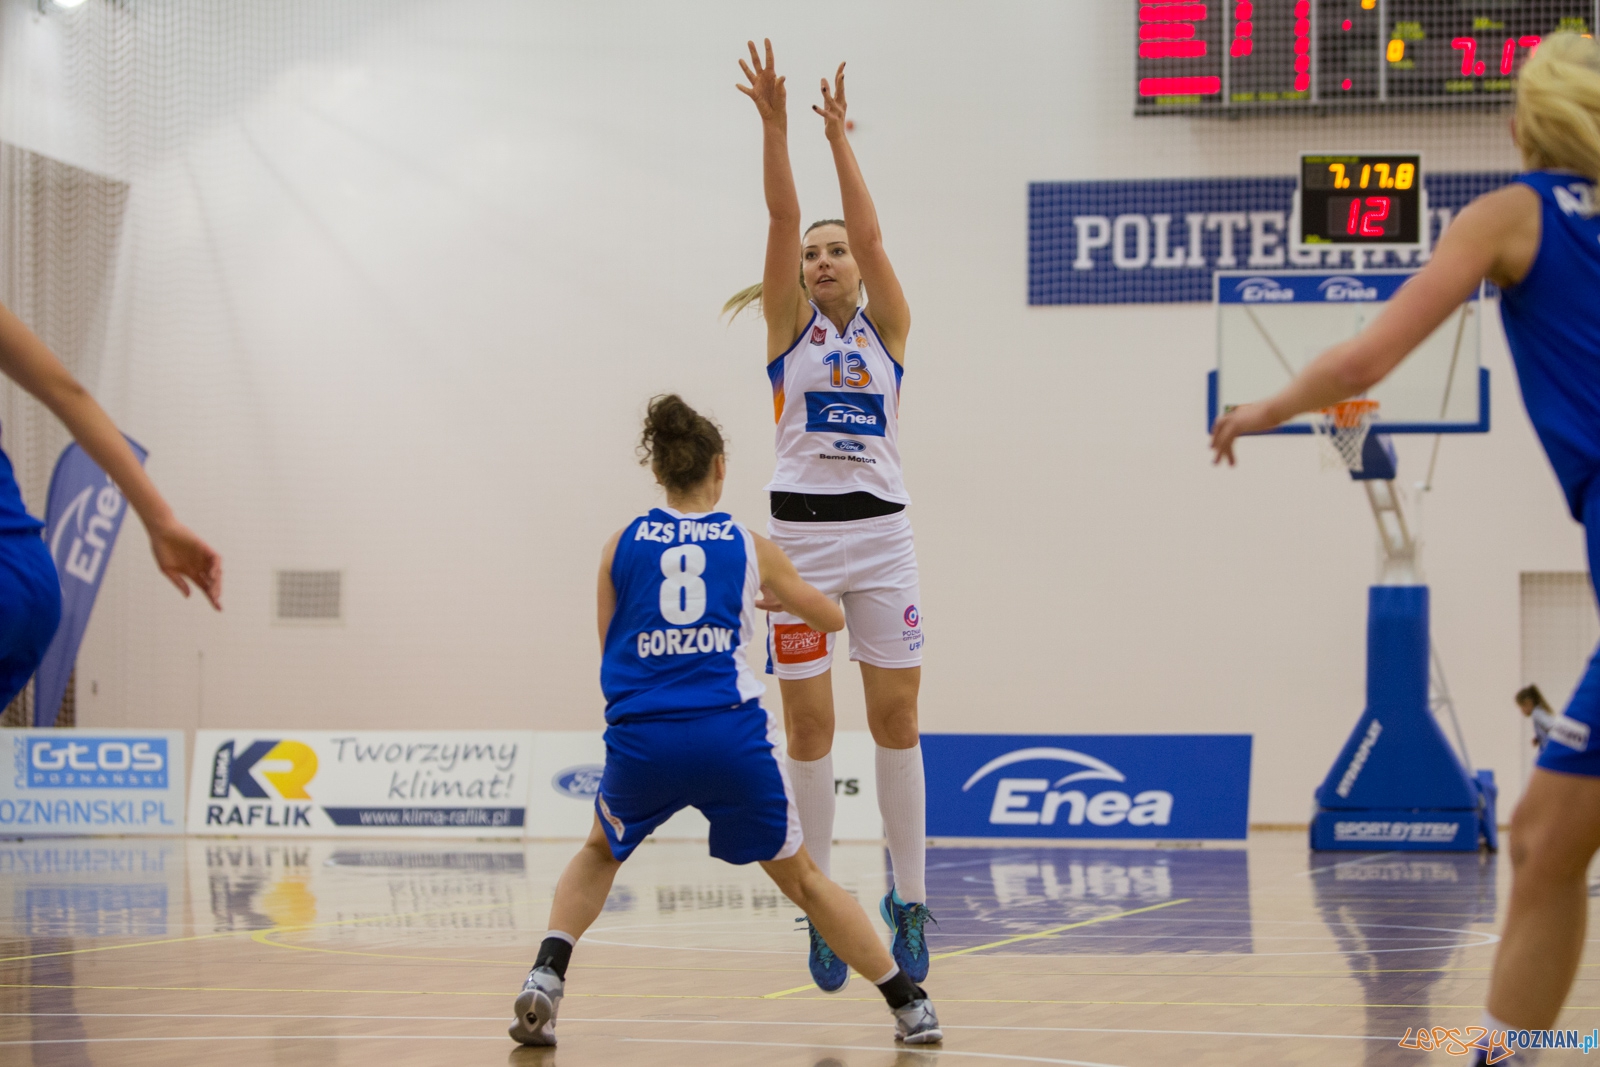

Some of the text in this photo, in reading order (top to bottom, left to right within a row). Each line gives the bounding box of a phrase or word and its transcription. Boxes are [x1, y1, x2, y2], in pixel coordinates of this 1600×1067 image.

[1328, 163, 1415, 190] 7.17.8
[1346, 196, 1391, 237] 12
[822, 350, 873, 389] 13
[827, 409, 877, 425] Enea
[847, 455, 877, 465] Motors
[64, 472, 122, 585] Ene
[634, 520, 735, 544] AZS PWSZ
[659, 544, 707, 626] 8
[637, 624, 734, 658] GORZÓW
[331, 737, 517, 772] Tworzymy
[388, 770, 516, 800] klimat!
[206, 804, 312, 827] RAFLIK
[359, 809, 511, 827] www.klima-raflik.pl
[989, 778, 1174, 826] Enea
